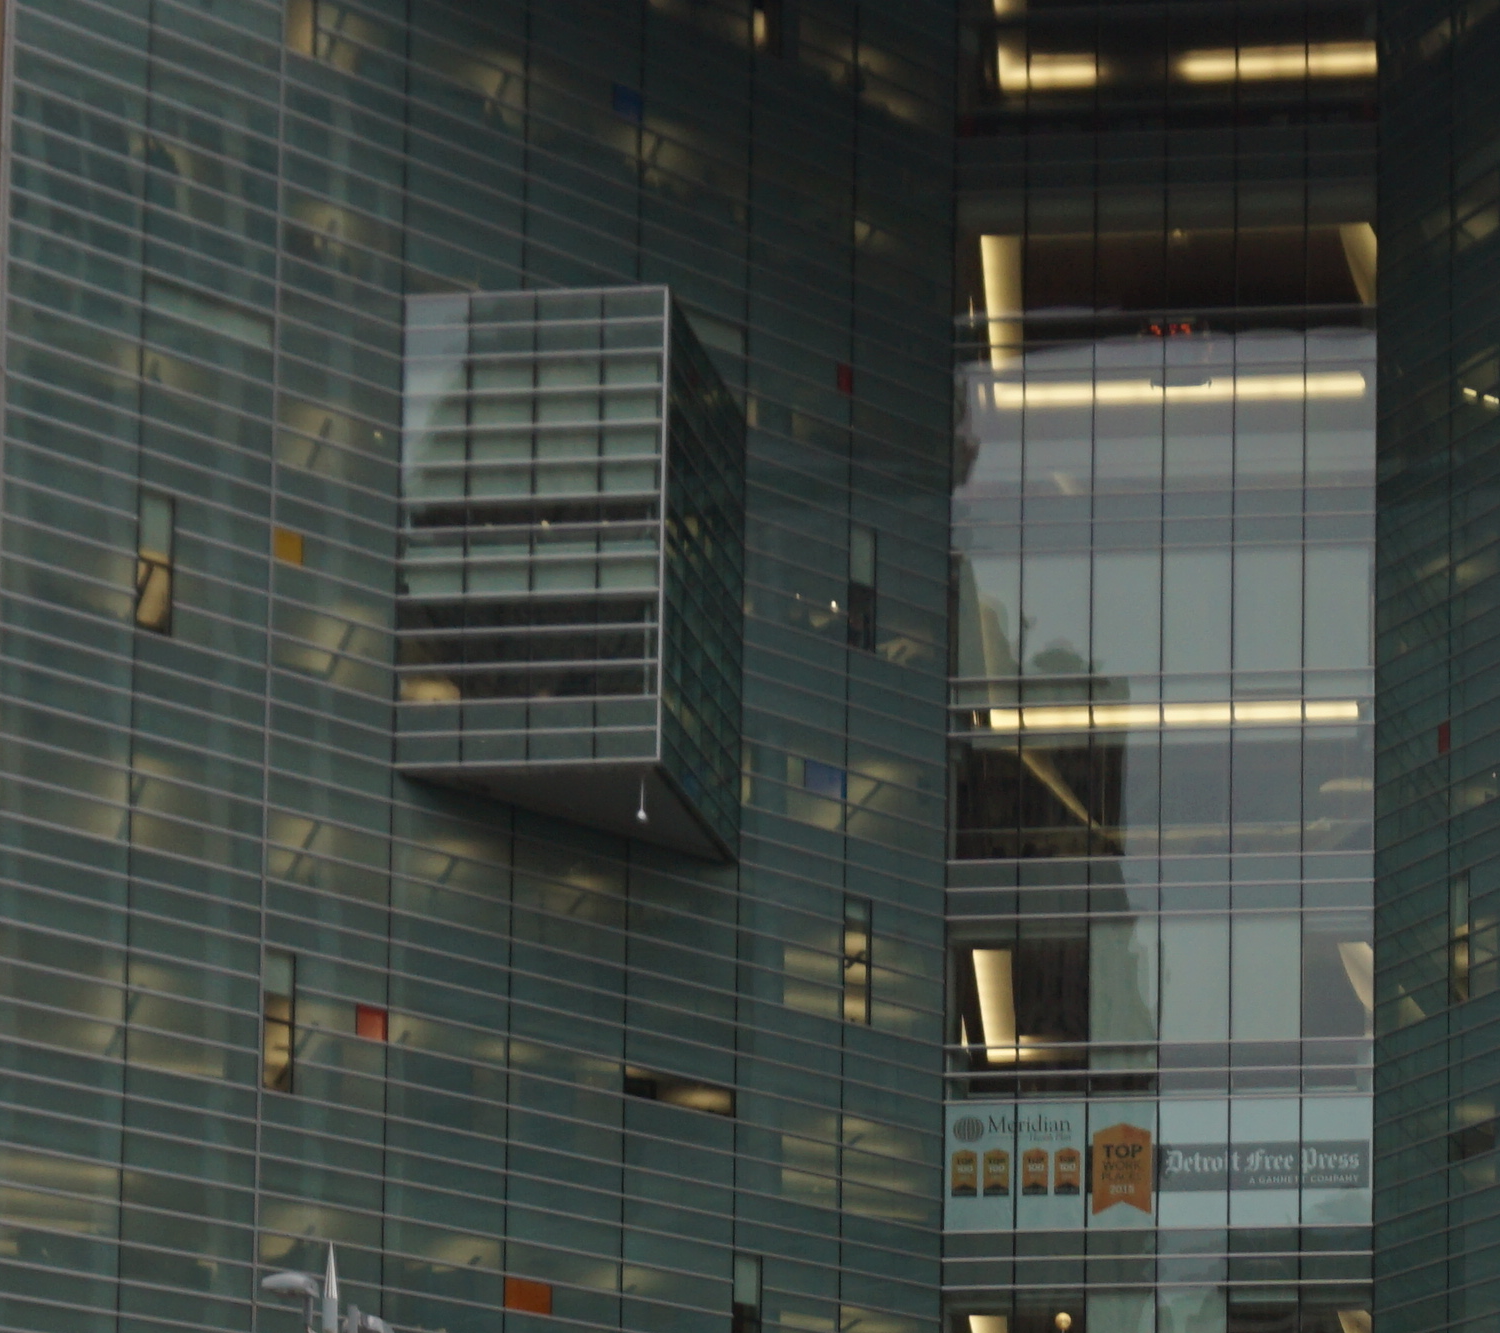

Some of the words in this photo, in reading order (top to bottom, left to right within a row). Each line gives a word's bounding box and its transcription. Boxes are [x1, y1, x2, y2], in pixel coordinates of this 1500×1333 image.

[988, 1114, 1071, 1133] Meridian
[1103, 1144, 1143, 1159] TOP
[1164, 1149, 1241, 1174] Detroit
[1245, 1148, 1295, 1172] Free
[1301, 1146, 1361, 1174] Press
